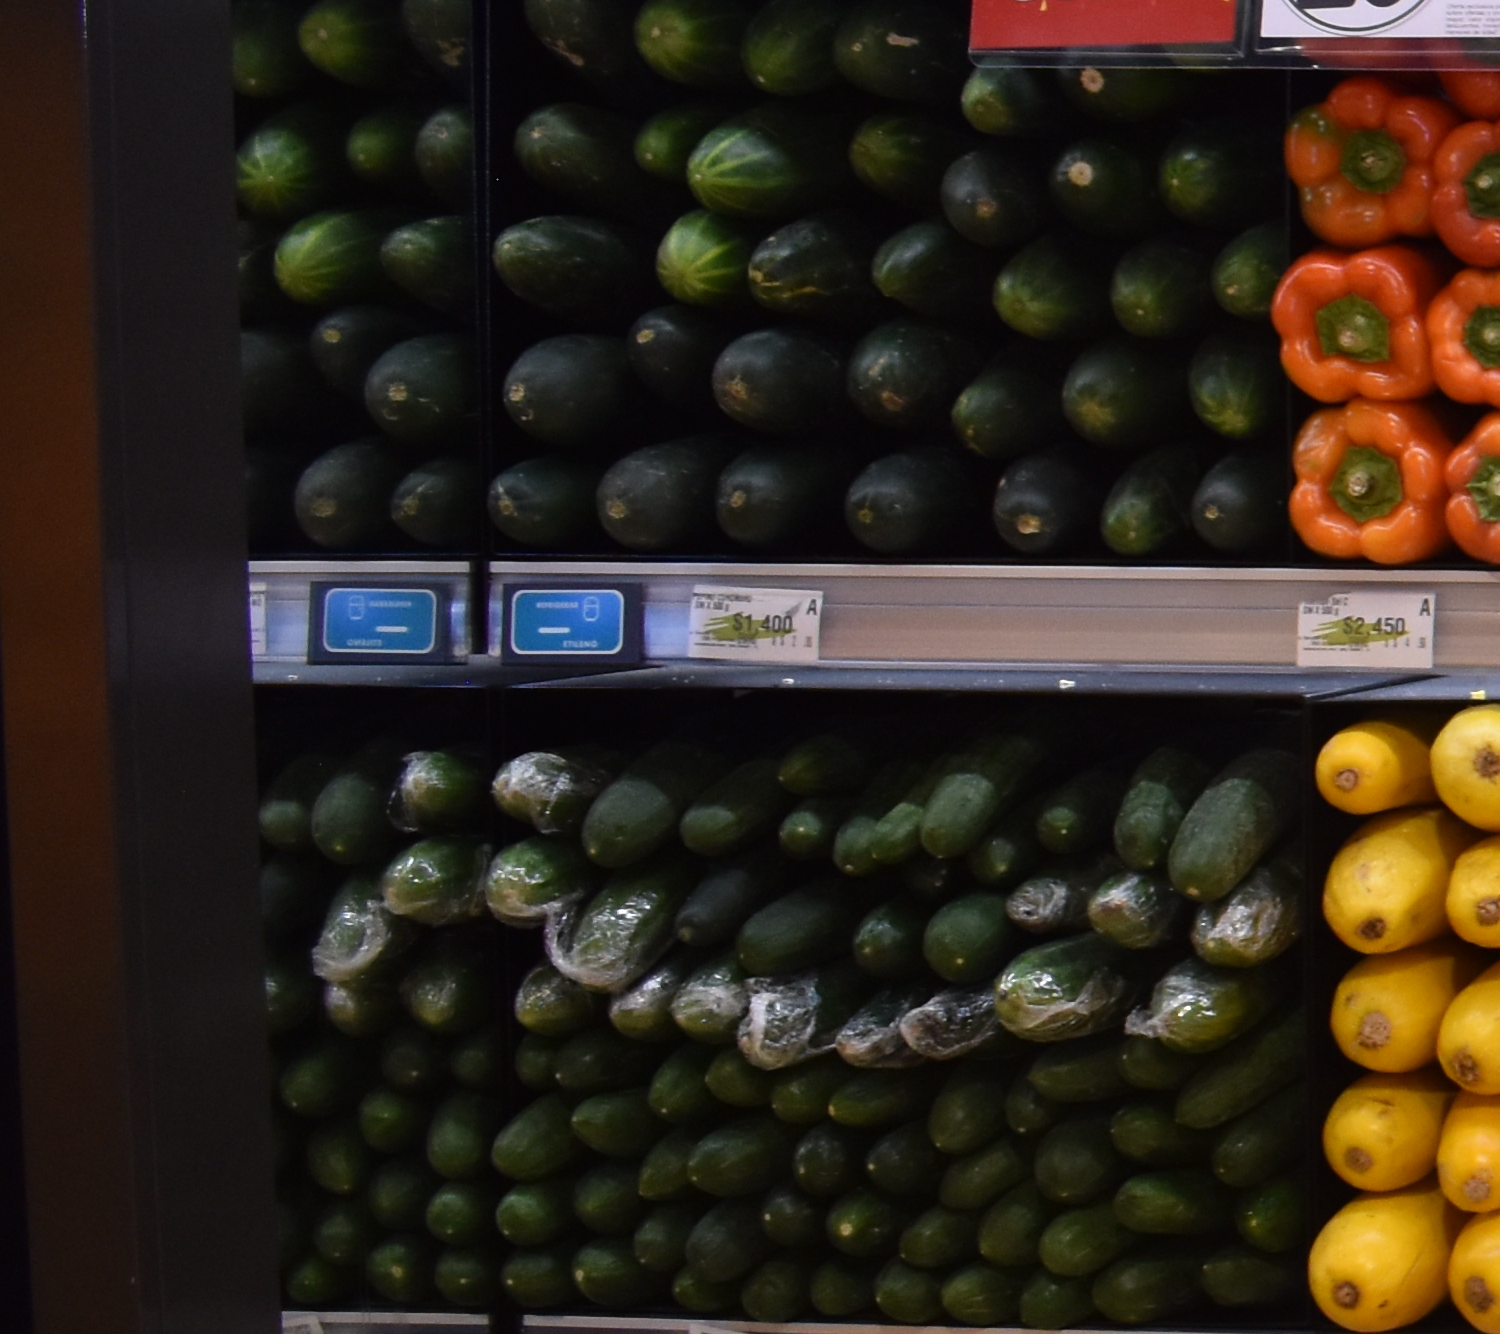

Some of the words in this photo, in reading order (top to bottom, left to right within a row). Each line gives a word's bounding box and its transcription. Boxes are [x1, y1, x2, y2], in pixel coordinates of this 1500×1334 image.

[806, 599, 817, 615] A
[1420, 599, 1430, 616] A
[1343, 617, 1405, 636] $2,450
